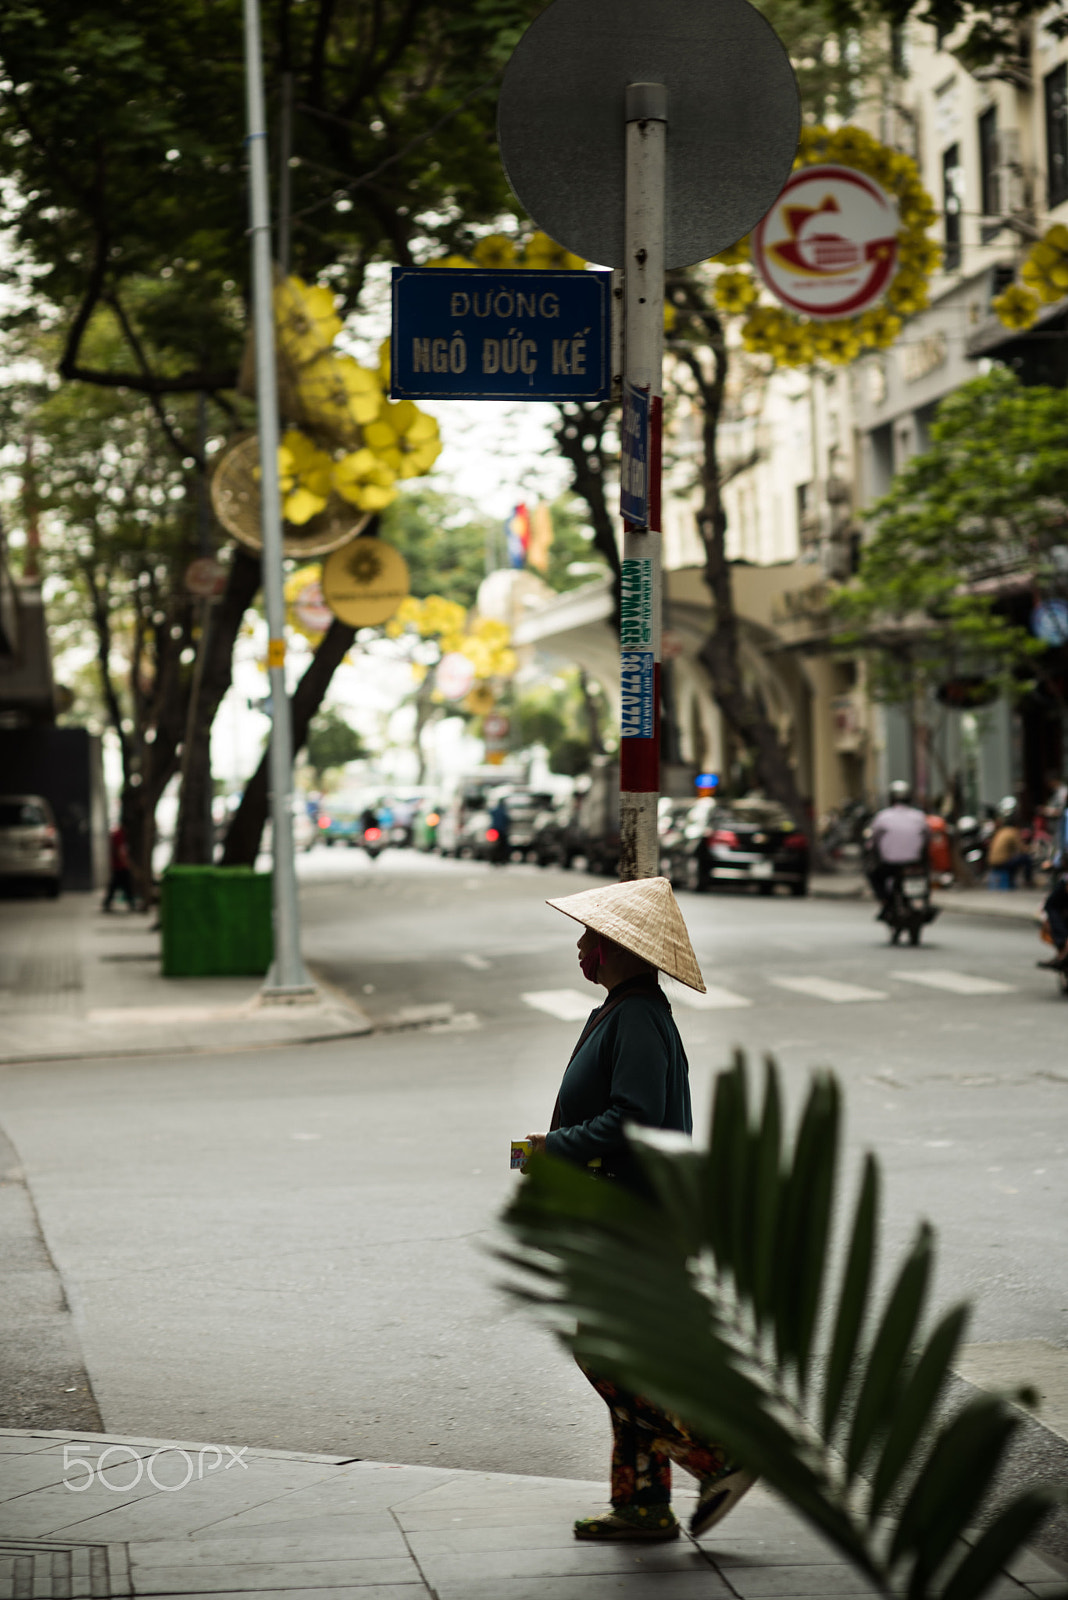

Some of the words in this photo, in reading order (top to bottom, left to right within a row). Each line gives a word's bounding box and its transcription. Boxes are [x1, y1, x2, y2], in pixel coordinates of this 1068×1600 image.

[451, 286, 560, 318] ĐƯỜNG
[413, 330, 467, 374] NGÔ
[482, 328, 538, 375] ĐỨC
[552, 327, 592, 375] KẾ
